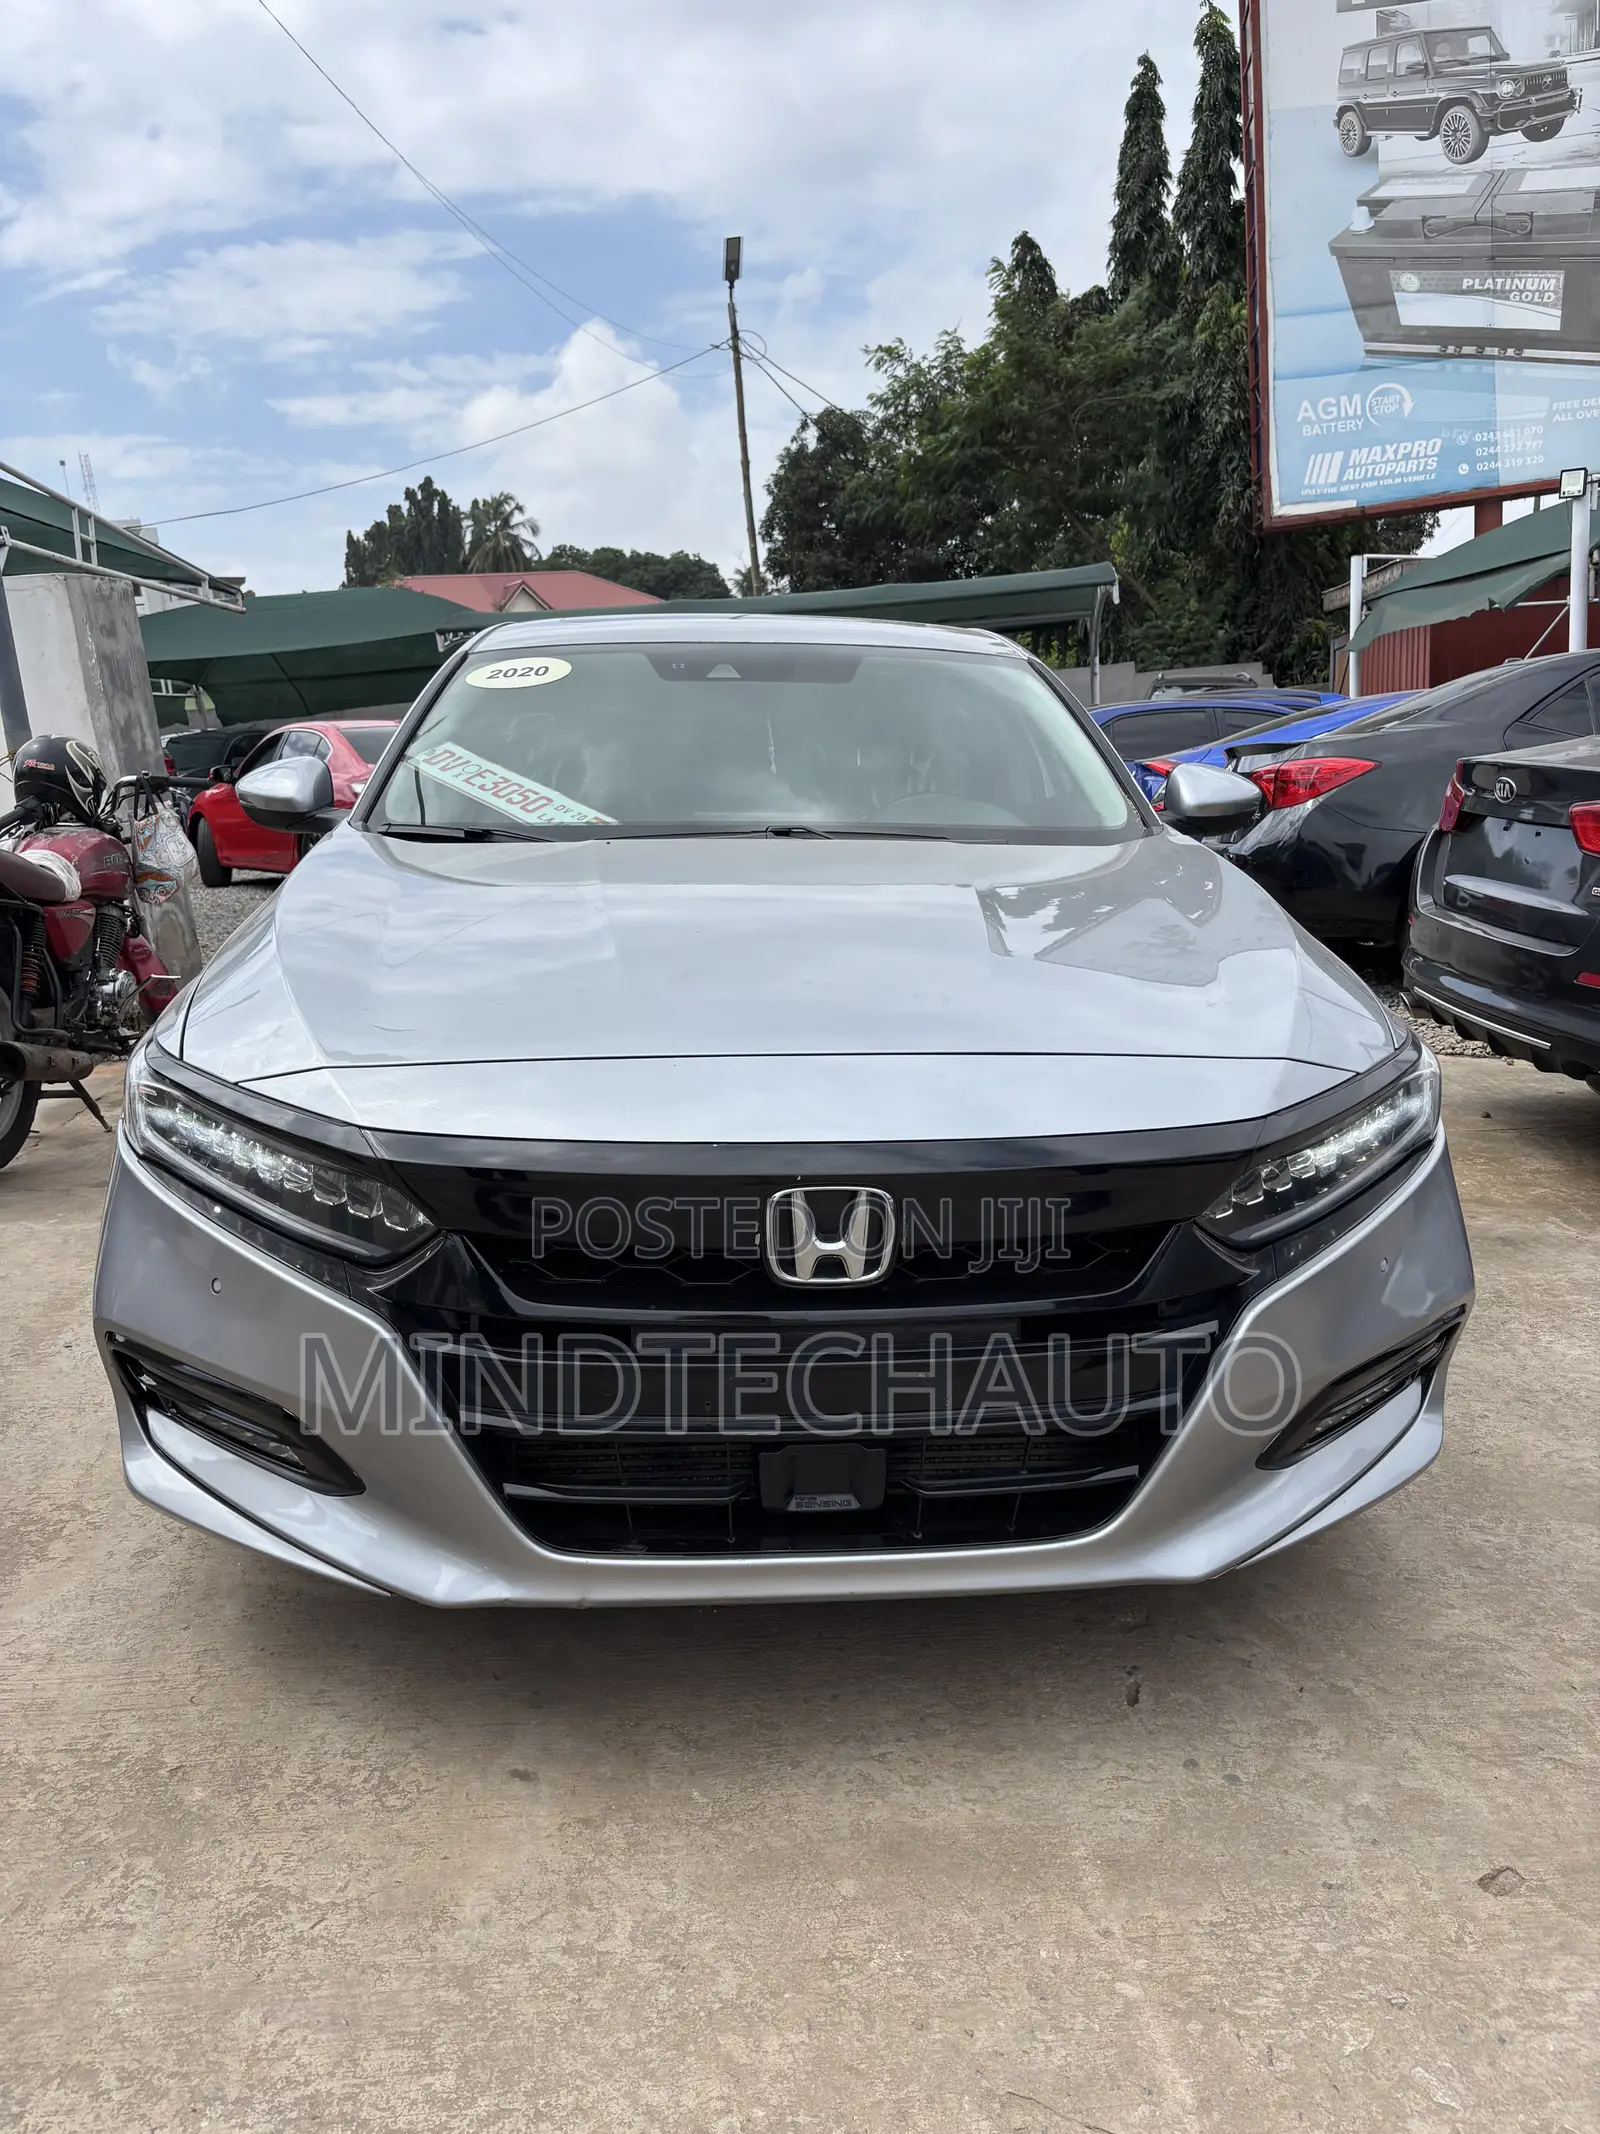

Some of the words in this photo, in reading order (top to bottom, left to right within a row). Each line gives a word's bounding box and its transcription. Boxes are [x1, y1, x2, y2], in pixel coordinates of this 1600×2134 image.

[1462, 278, 1556, 291] PLATINUM
[1509, 291, 1556, 303] GOLD
[1371, 394, 1401, 407] START
[1553, 399, 1580, 411] FREE
[1296, 393, 1362, 422] AGM
[1373, 404, 1399, 415] STOP
[1552, 412, 1574, 422] ALL
[1302, 418, 1364, 436] BATTERY
[1475, 431, 1500, 442] 0243
[1348, 438, 1443, 466] MAXPRO
[1475, 446, 1500, 456] 0244
[1342, 457, 1438, 481] AUTOPARTS
[1476, 460, 1501, 471] 0244
[1504, 458, 1523, 468] 319
[1525, 455, 1544, 464] 320
[485, 666, 549, 680] 2020
[422, 749, 472, 772] DV
[462, 768, 554, 814] E3050
[554, 804, 573, 814] DV
[571, 812, 588, 821] 20
[795, 1500, 852, 1509] SENSING
